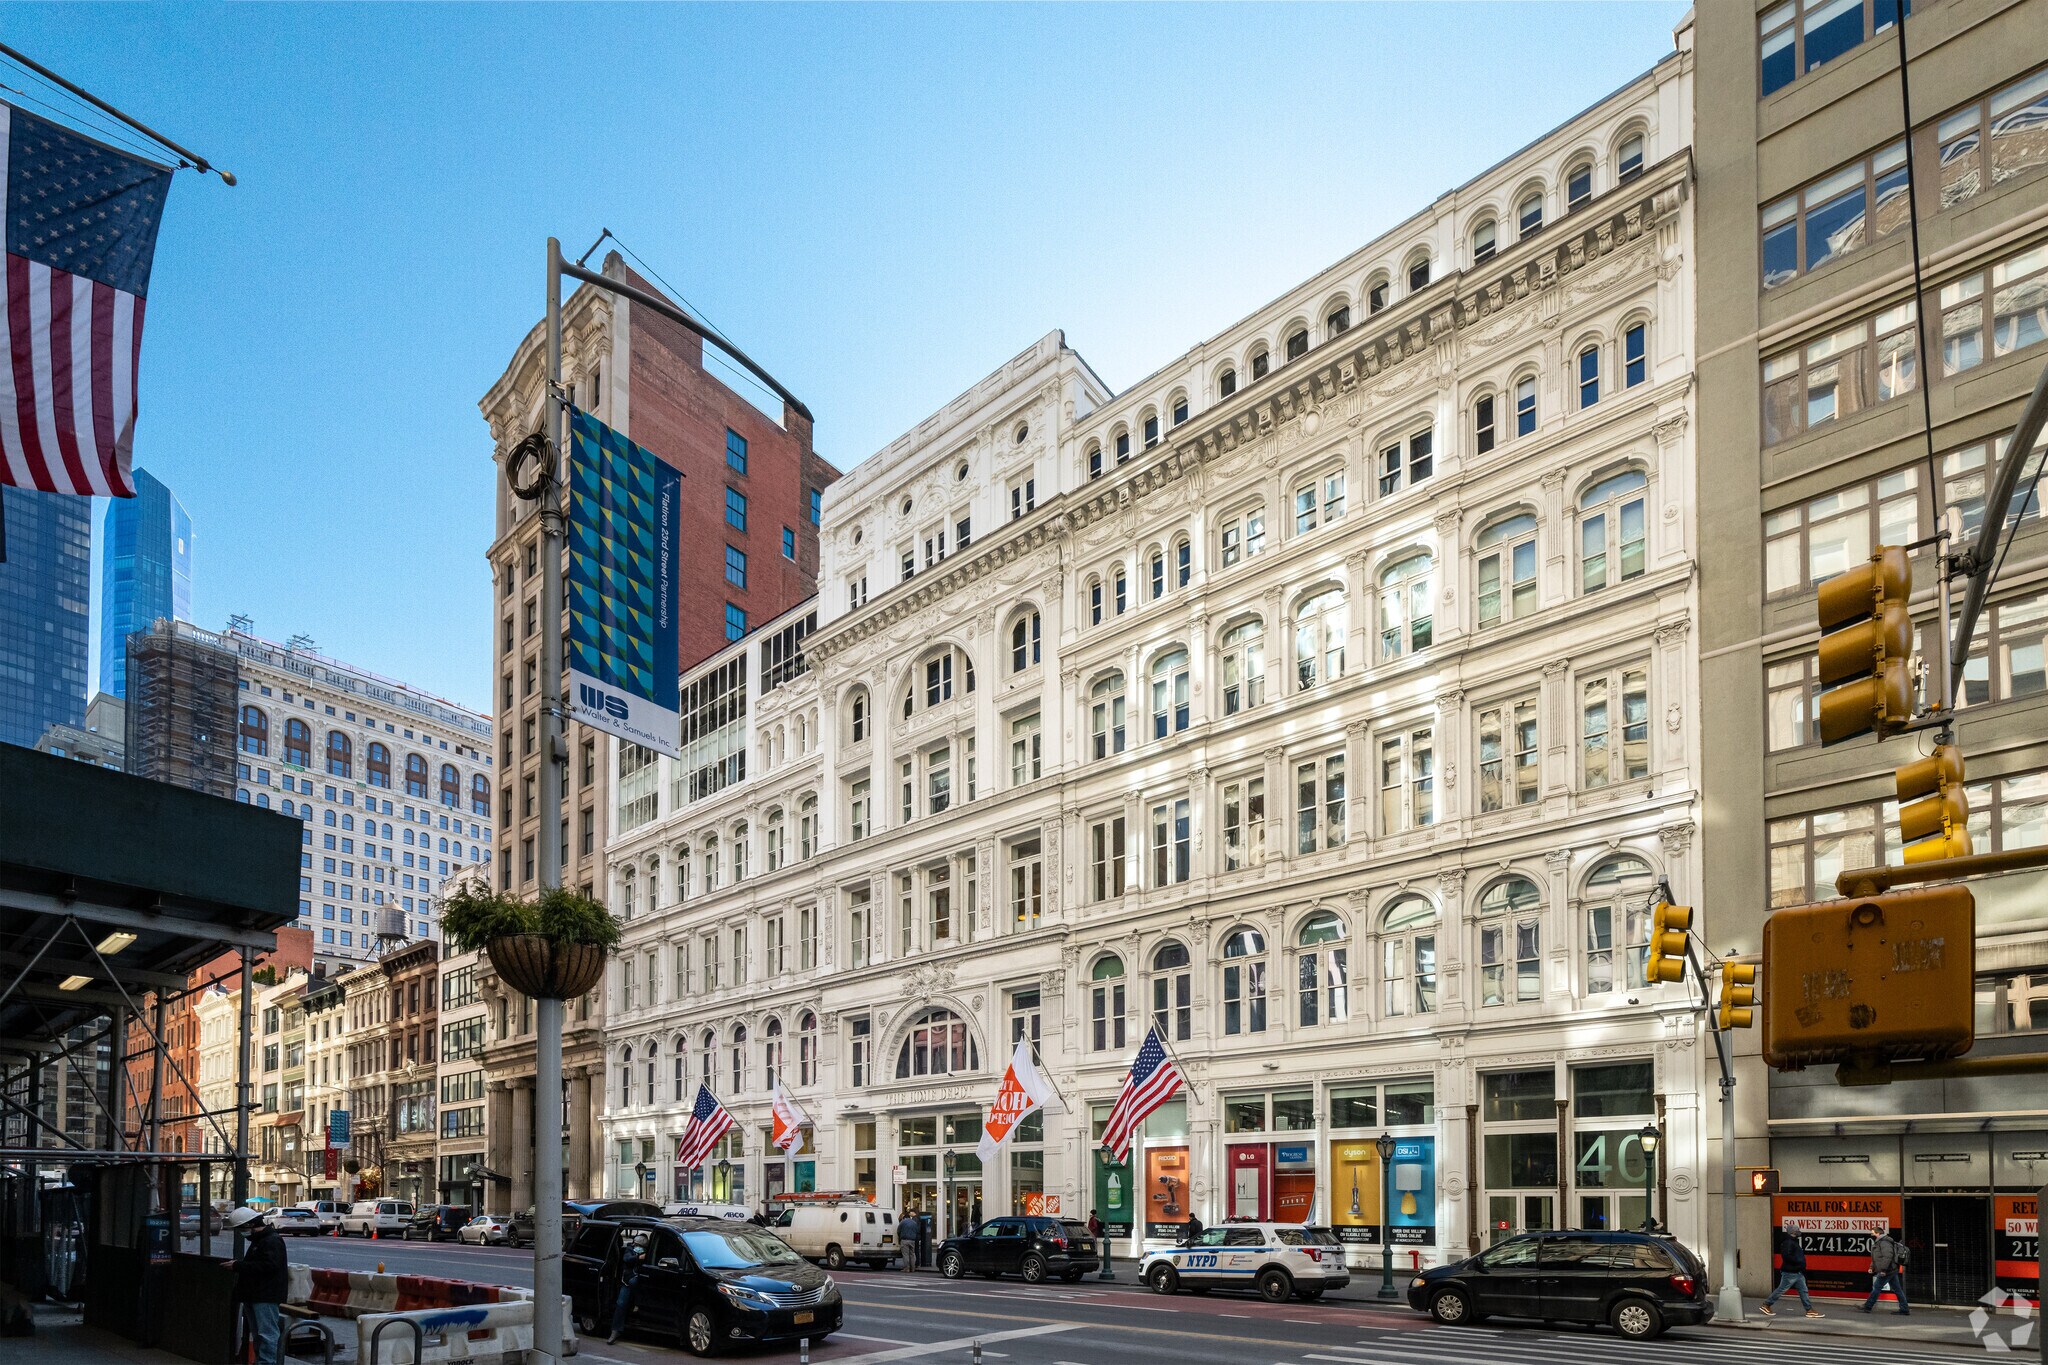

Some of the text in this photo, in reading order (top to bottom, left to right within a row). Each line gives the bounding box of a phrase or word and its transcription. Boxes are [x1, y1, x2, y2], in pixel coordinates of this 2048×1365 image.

[662, 492, 670, 526] Flatiron
[659, 578, 668, 628] Partnership
[580, 705, 672, 748] Walter & Samuels Inc.
[886, 1085, 974, 1106] THE HOME DEPOT
[1344, 1148, 1366, 1158] dyson
[1788, 1200, 1882, 1213] RETAIL FOR LEASE
[2012, 1202, 2037, 1214] RET
[1798, 1220, 1822, 1230] WEST
[1824, 1220, 1849, 1230] 23RD
[1852, 1220, 1887, 1230] STREET
[2008, 1222, 2021, 1232] 50
[159, 1229, 169, 1240] P
[1187, 1255, 1217, 1267] NYPD
